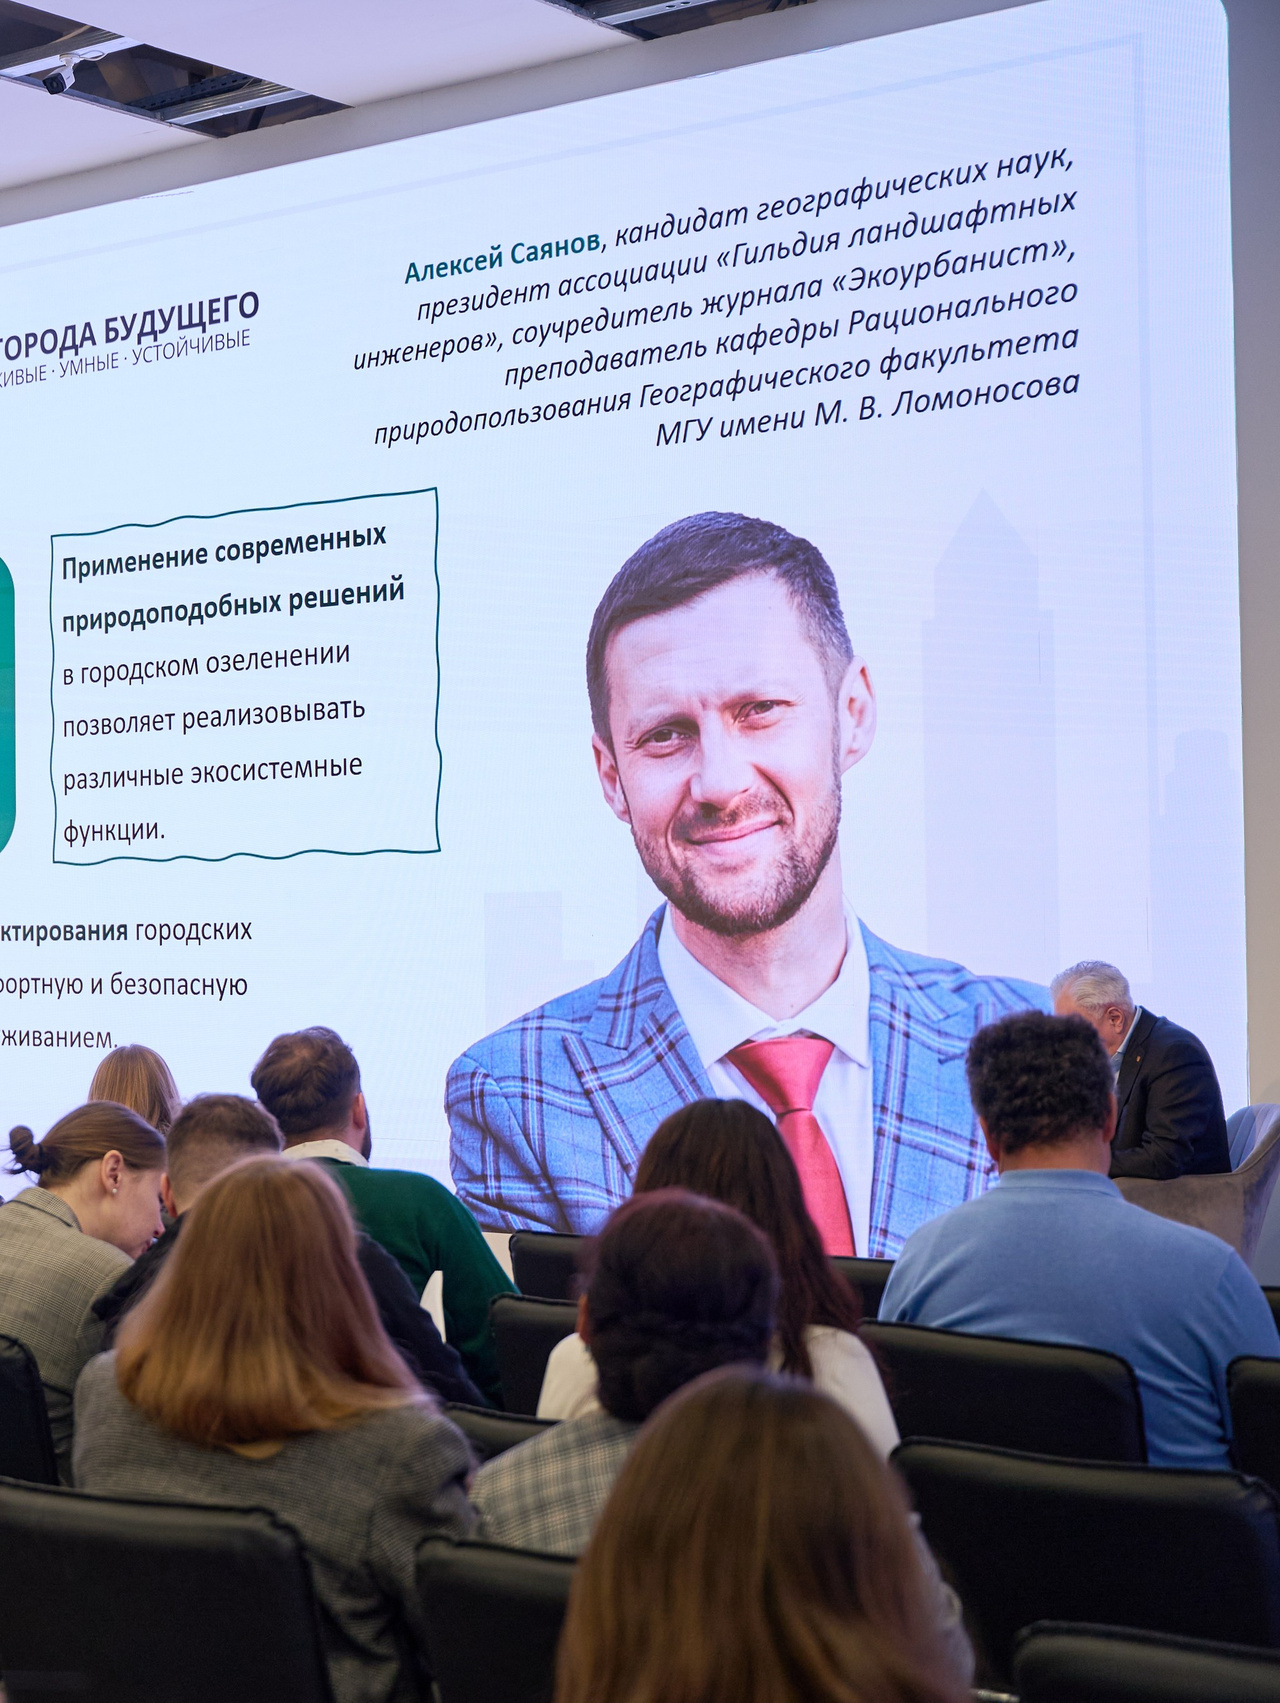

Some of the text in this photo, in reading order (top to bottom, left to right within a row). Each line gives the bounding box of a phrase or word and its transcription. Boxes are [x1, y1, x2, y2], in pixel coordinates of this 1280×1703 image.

[404, 147, 1075, 285] Алексей Саянов, кандидат географических наук,
[417, 190, 1078, 325] президент ассоциации «Гильдия ландшафтных
[104, 290, 260, 346] БУДУЩЕГО
[353, 239, 1075, 371] инженеров», соучредитель журнала «Экоурбанист»,
[59, 351, 119, 379] УМНЫЕ
[131, 328, 251, 366] УСТОЙЧИВЫЕ
[504, 282, 1079, 391] преподаватель кафедры Рационального
[374, 328, 1080, 449] природопользования Географического факультета
[655, 373, 1081, 447] МГУ имени М. В. Ломоносова
[62, 525, 387, 584] Применение современных
[62, 573, 405, 637] природоподобных решений
[63, 644, 350, 688] в городском озеленении
[63, 699, 366, 738] позволяет реализовывать
[63, 756, 363, 797] различные экосистемные
[63, 818, 165, 848] функции.
[135, 921, 253, 947] городских
[91, 977, 103, 995] и
[110, 970, 248, 1002] безопасную
